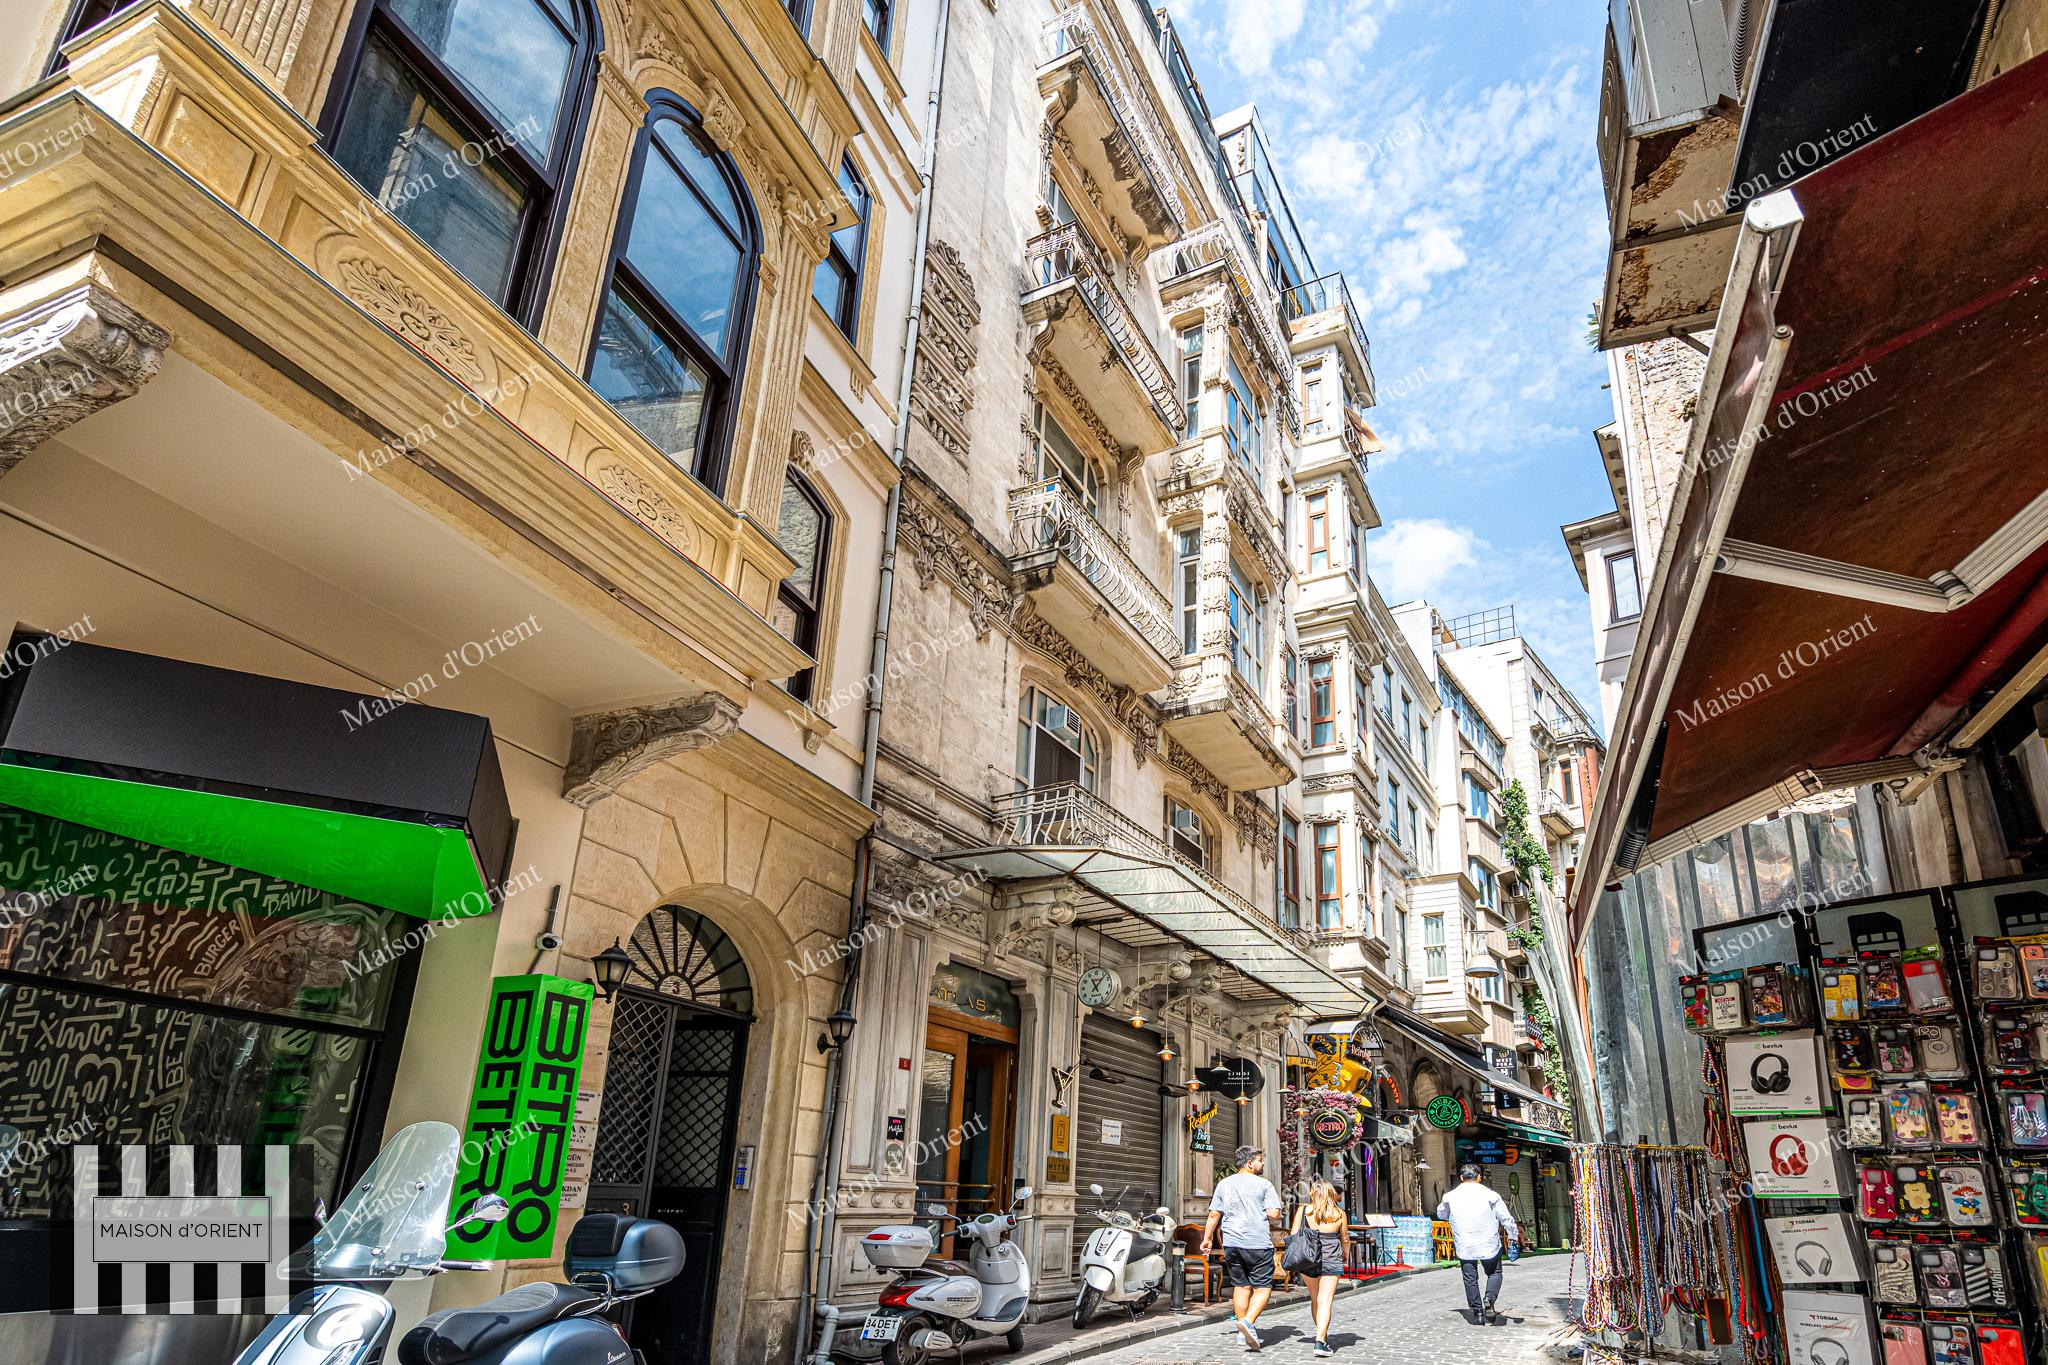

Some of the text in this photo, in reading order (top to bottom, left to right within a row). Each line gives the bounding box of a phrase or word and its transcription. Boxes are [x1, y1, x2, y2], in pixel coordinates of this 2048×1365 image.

[194, 919, 240, 976] BURGER
[672, 981, 680, 994] 3
[455, 990, 534, 1243] BETRO
[507, 992, 586, 1243] BETRO
[874, 1329, 886, 1338] 33
